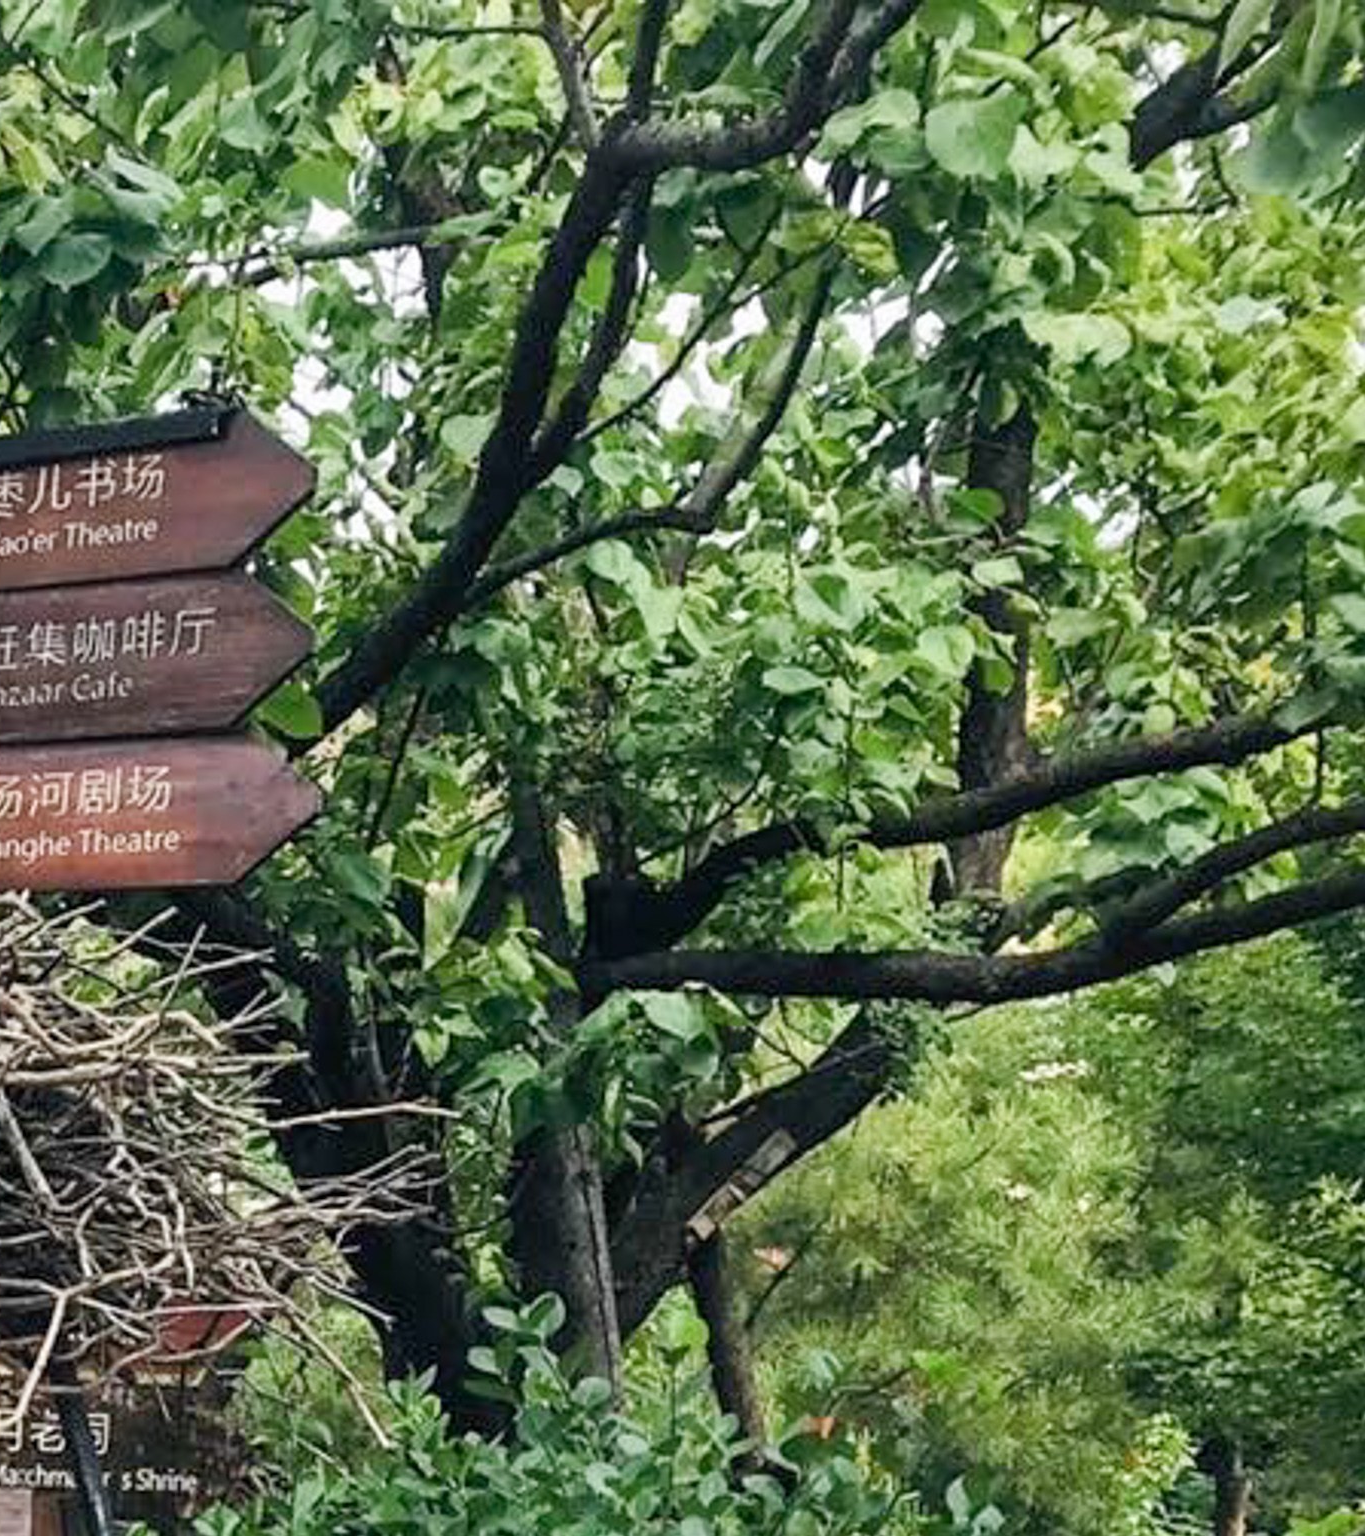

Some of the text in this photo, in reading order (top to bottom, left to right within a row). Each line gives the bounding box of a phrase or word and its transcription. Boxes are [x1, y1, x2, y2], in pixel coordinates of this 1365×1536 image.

[64, 518, 159, 549] Theatre
[71, 670, 134, 701] Cafe
[78, 826, 181, 855] Theatre
[135, 1467, 198, 1494] Shrine
